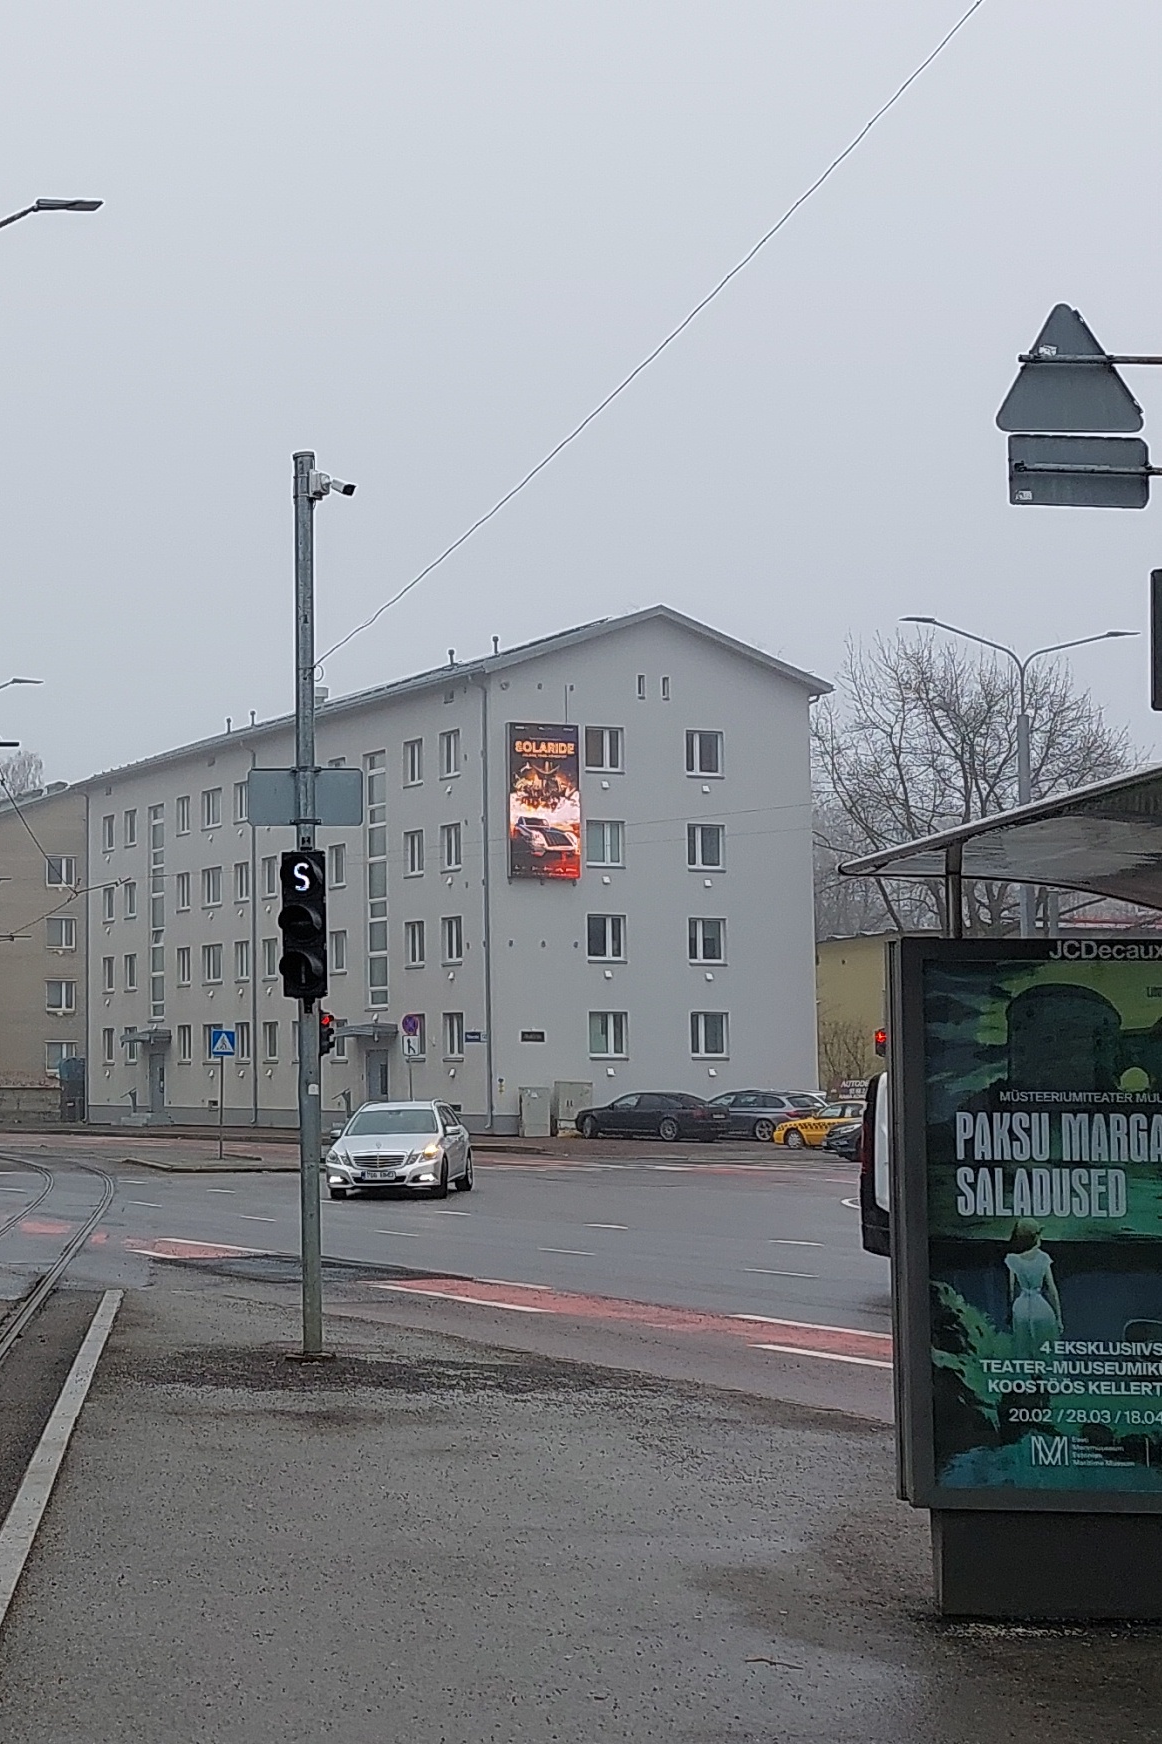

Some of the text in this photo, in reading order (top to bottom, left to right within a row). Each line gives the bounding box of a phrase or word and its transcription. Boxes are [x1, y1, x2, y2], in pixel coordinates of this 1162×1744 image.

[293, 862, 311, 891] S
[956, 1111, 1162, 1163] PAKSU MARGA
[956, 1166, 1127, 1218] SALADUSED
[1040, 1341, 1052, 1354] 4
[979, 1359, 1162, 1376] TEATER-MUUSEUMIK
[988, 1378, 1085, 1394] KOOSTÖÖS
[1008, 1408, 1053, 1422] 20.02
[1066, 1409, 1111, 1424] 28.03
[1124, 1410, 1162, 1425] 18.04
